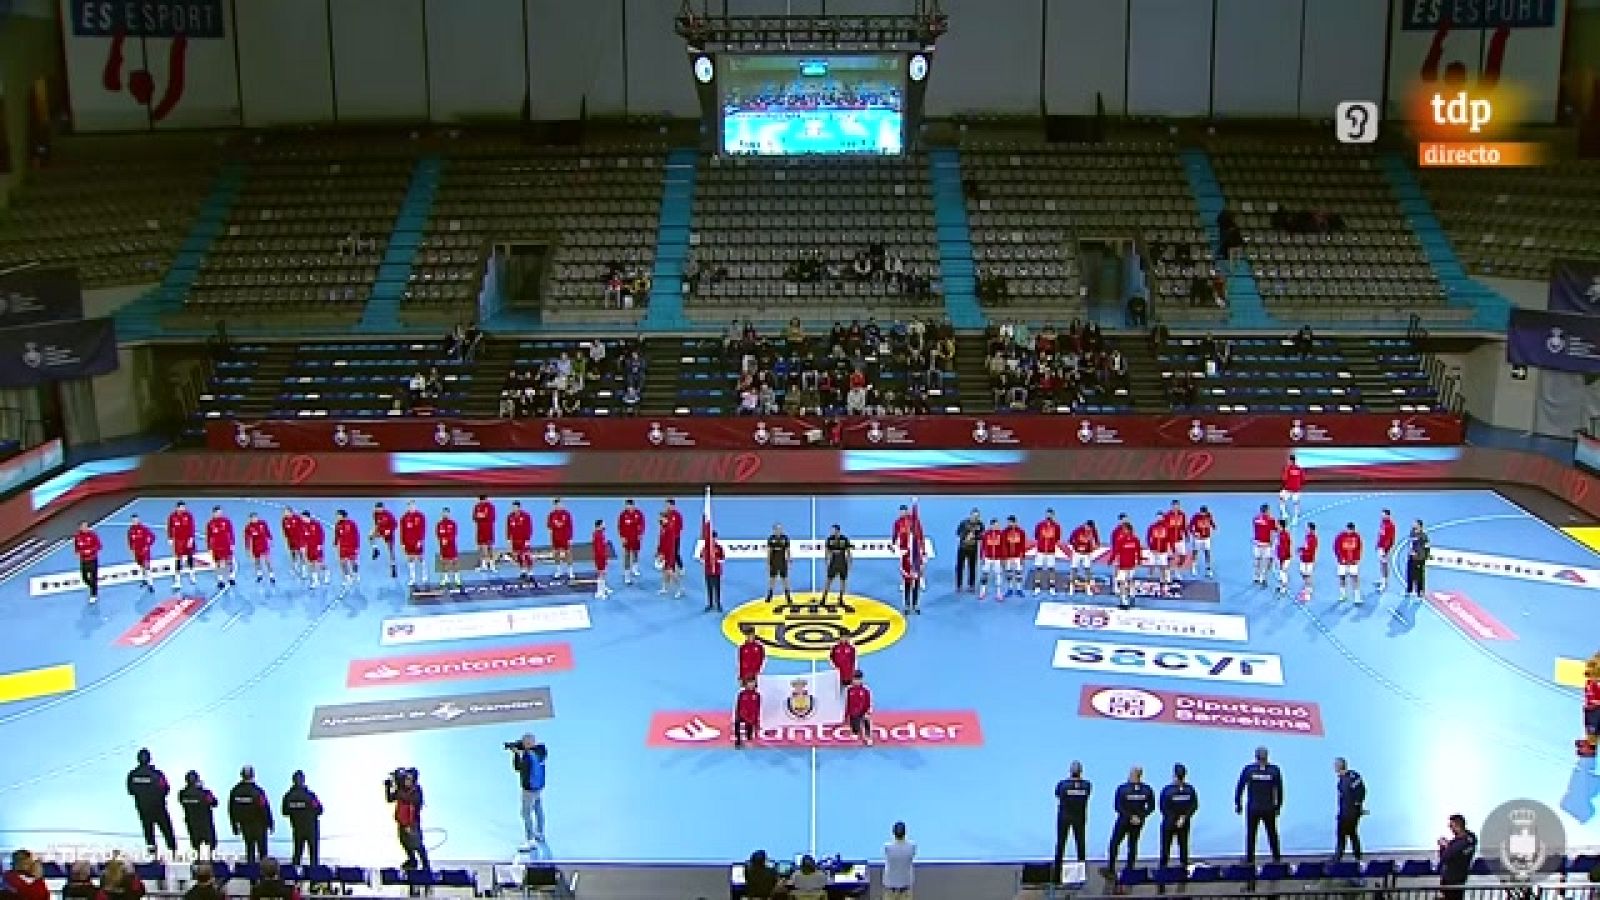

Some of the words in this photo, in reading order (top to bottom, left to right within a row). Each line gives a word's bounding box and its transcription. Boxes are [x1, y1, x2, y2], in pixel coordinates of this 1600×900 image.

[81, 2, 111, 32] ES
[124, 3, 216, 34] ESPORT
[1410, 0, 1439, 24] ES
[1451, 0, 1548, 23] ESPORT
[404, 654, 558, 677] Santander
[1067, 645, 1268, 677] sacyr
[1174, 696, 1309, 718] Diputació
[1174, 710, 1311, 733] Barcelona
